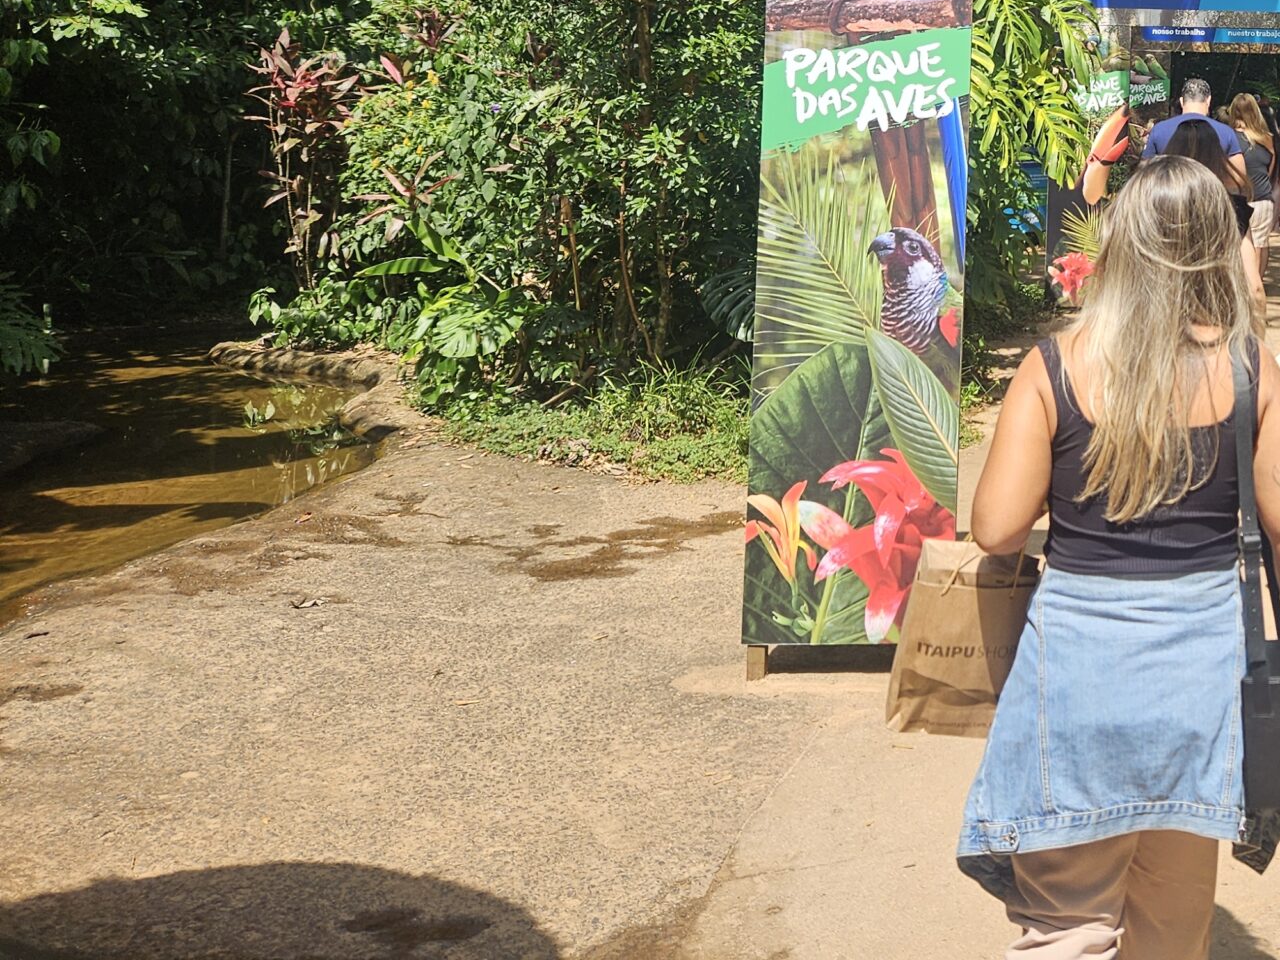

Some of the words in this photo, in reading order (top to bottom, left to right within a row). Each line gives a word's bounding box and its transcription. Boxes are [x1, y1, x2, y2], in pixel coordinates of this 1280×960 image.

[1174, 28, 1206, 36] trabalho
[783, 42, 946, 88] PARQUE
[792, 83, 858, 124] DAS
[855, 77, 957, 132] AVES
[1086, 89, 1125, 112] AVES
[1142, 91, 1167, 106] AVES
